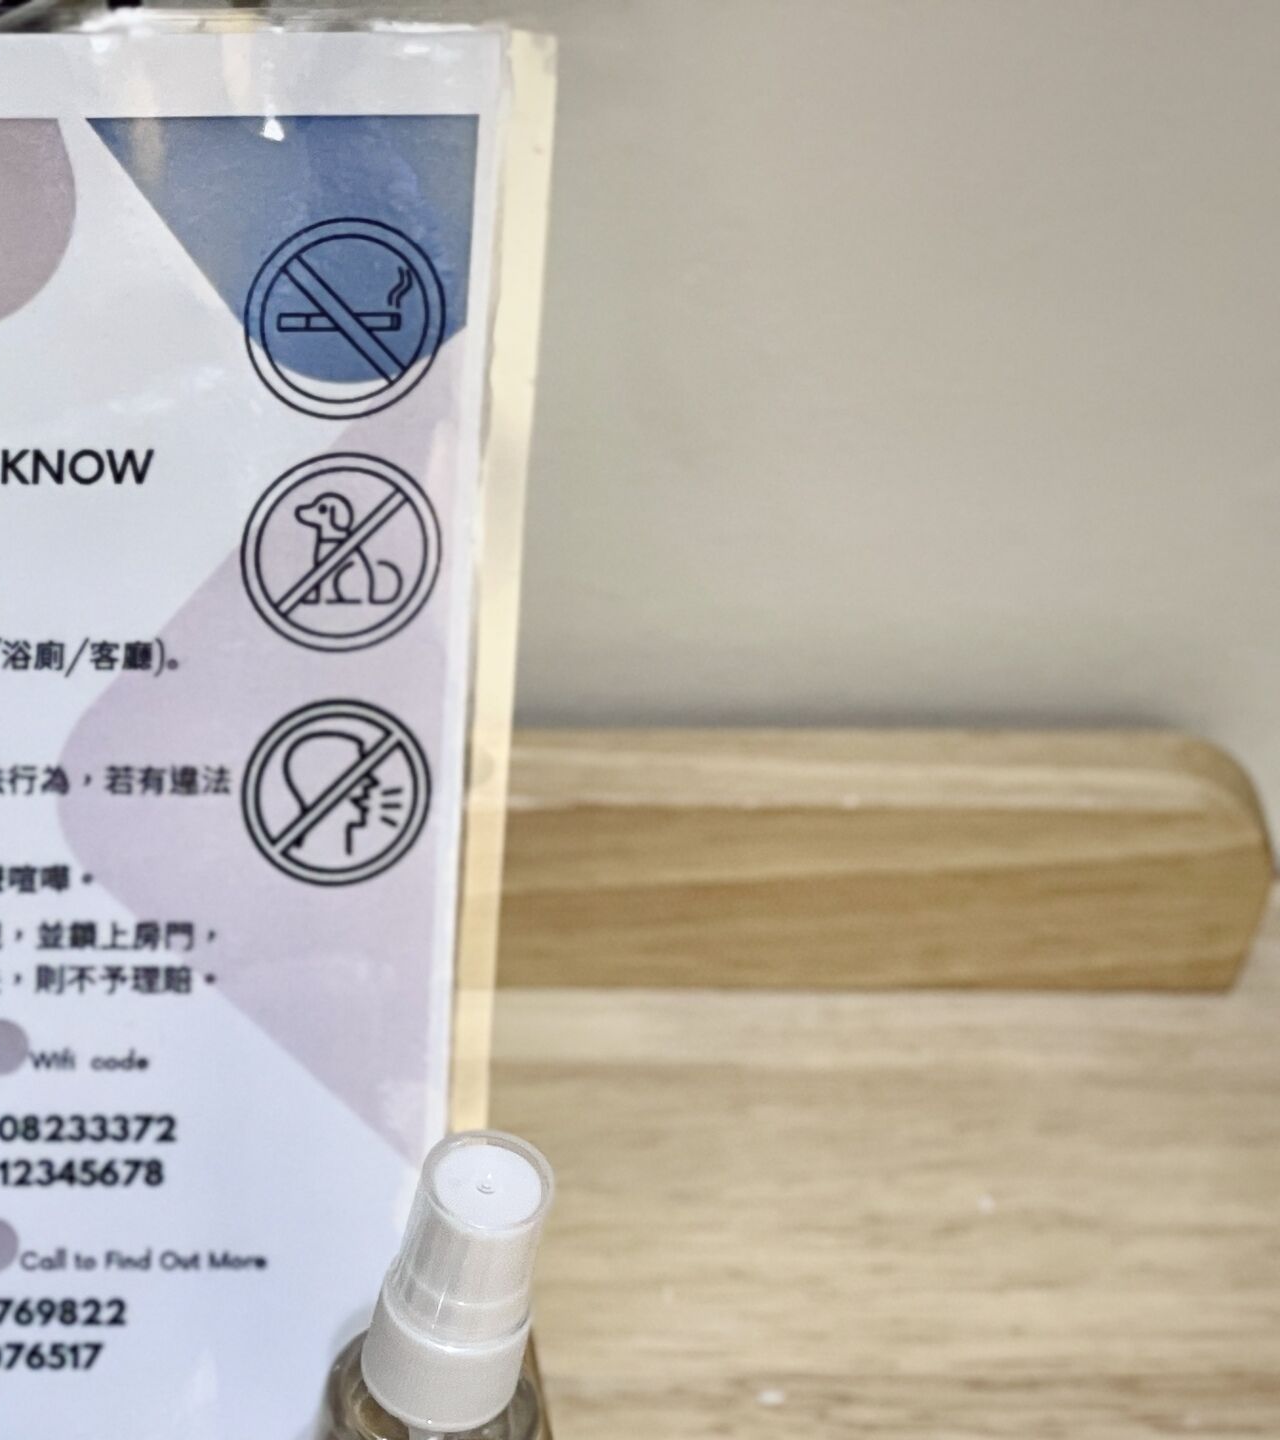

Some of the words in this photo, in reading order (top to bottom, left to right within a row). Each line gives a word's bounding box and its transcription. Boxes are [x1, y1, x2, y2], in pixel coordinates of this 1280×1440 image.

[0, 448, 155, 486] KNOW
[90, 1050, 149, 1071] code
[19, 1248, 66, 1272] Call
[74, 1251, 98, 1272] to
[105, 1249, 152, 1272] Find
[159, 1251, 200, 1272] Out
[209, 1252, 267, 1272] More
